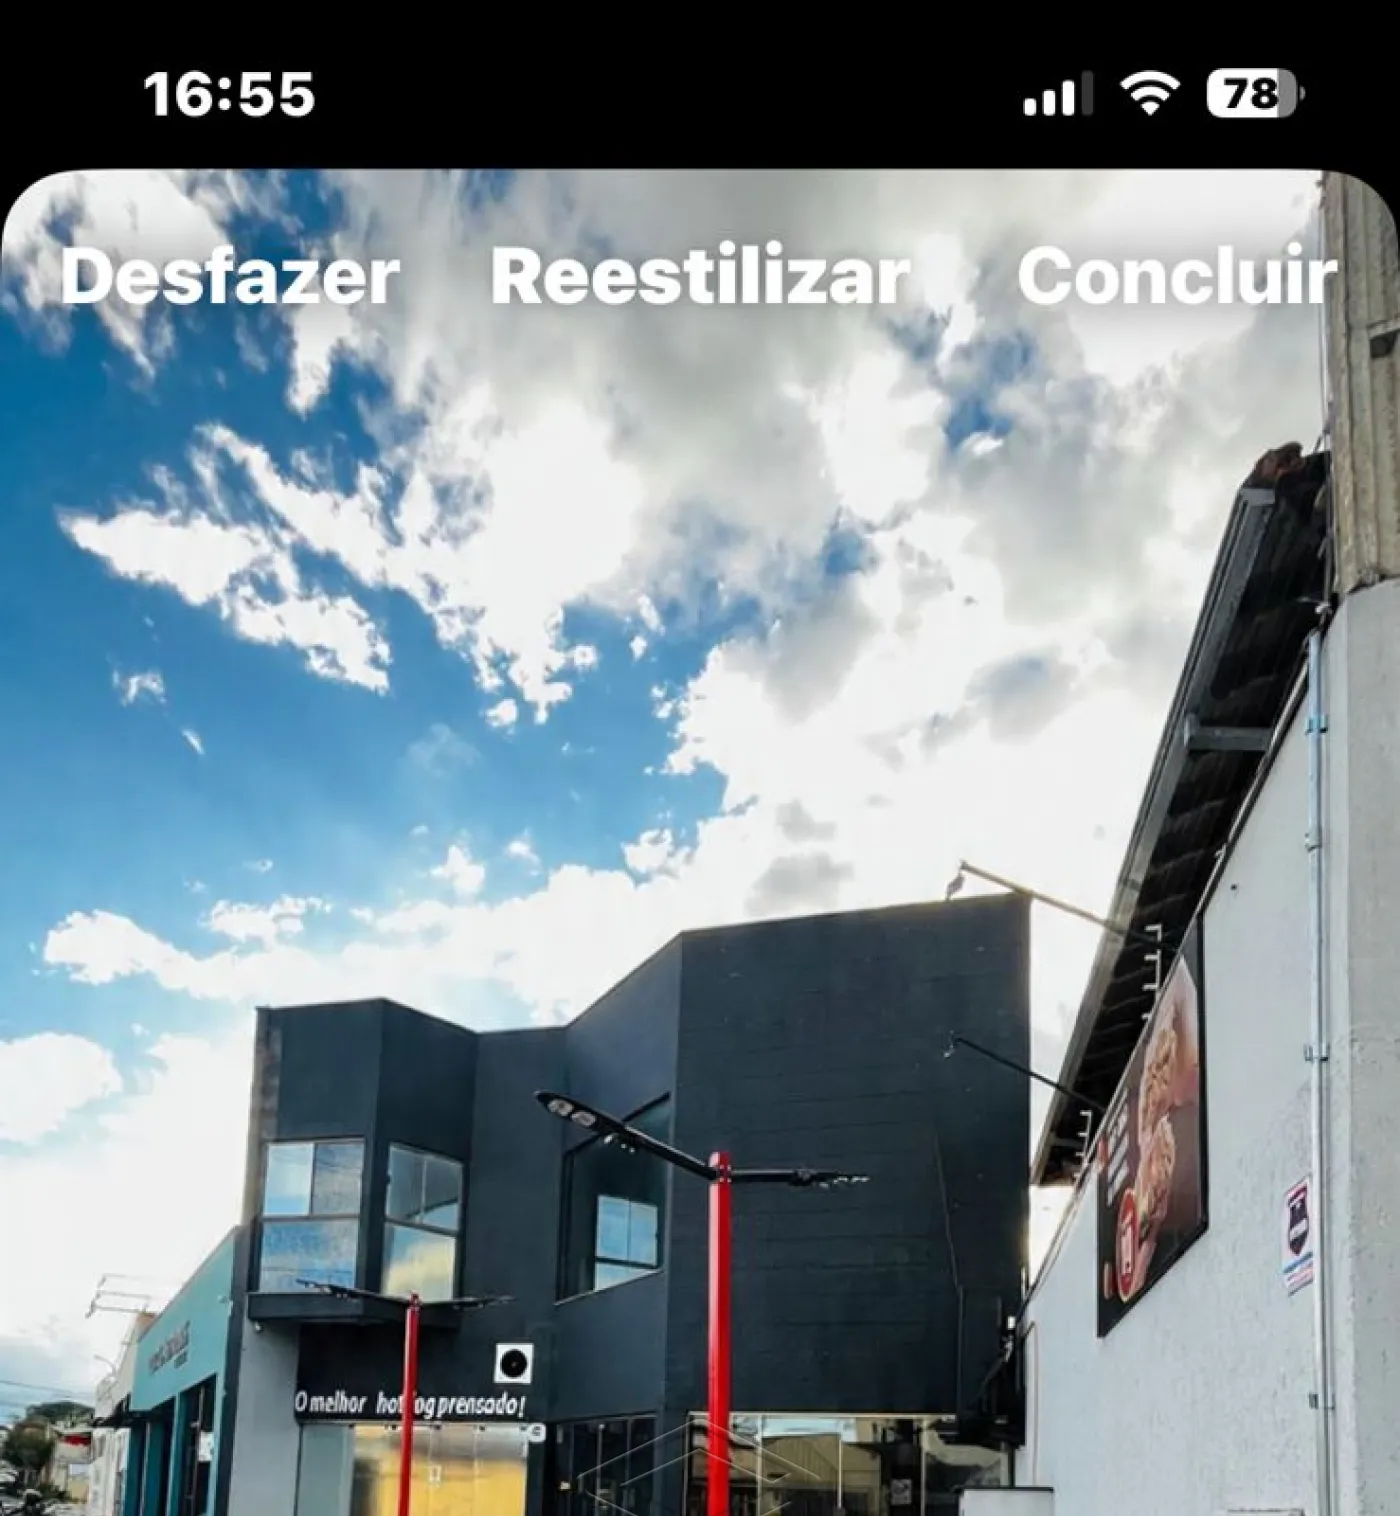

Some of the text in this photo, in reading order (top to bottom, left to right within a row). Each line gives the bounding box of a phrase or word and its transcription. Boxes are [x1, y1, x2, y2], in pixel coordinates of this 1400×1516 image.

[295, 1391, 308, 1412] O
[310, 1391, 367, 1413] melhor
[436, 1391, 526, 1418] prensado!
